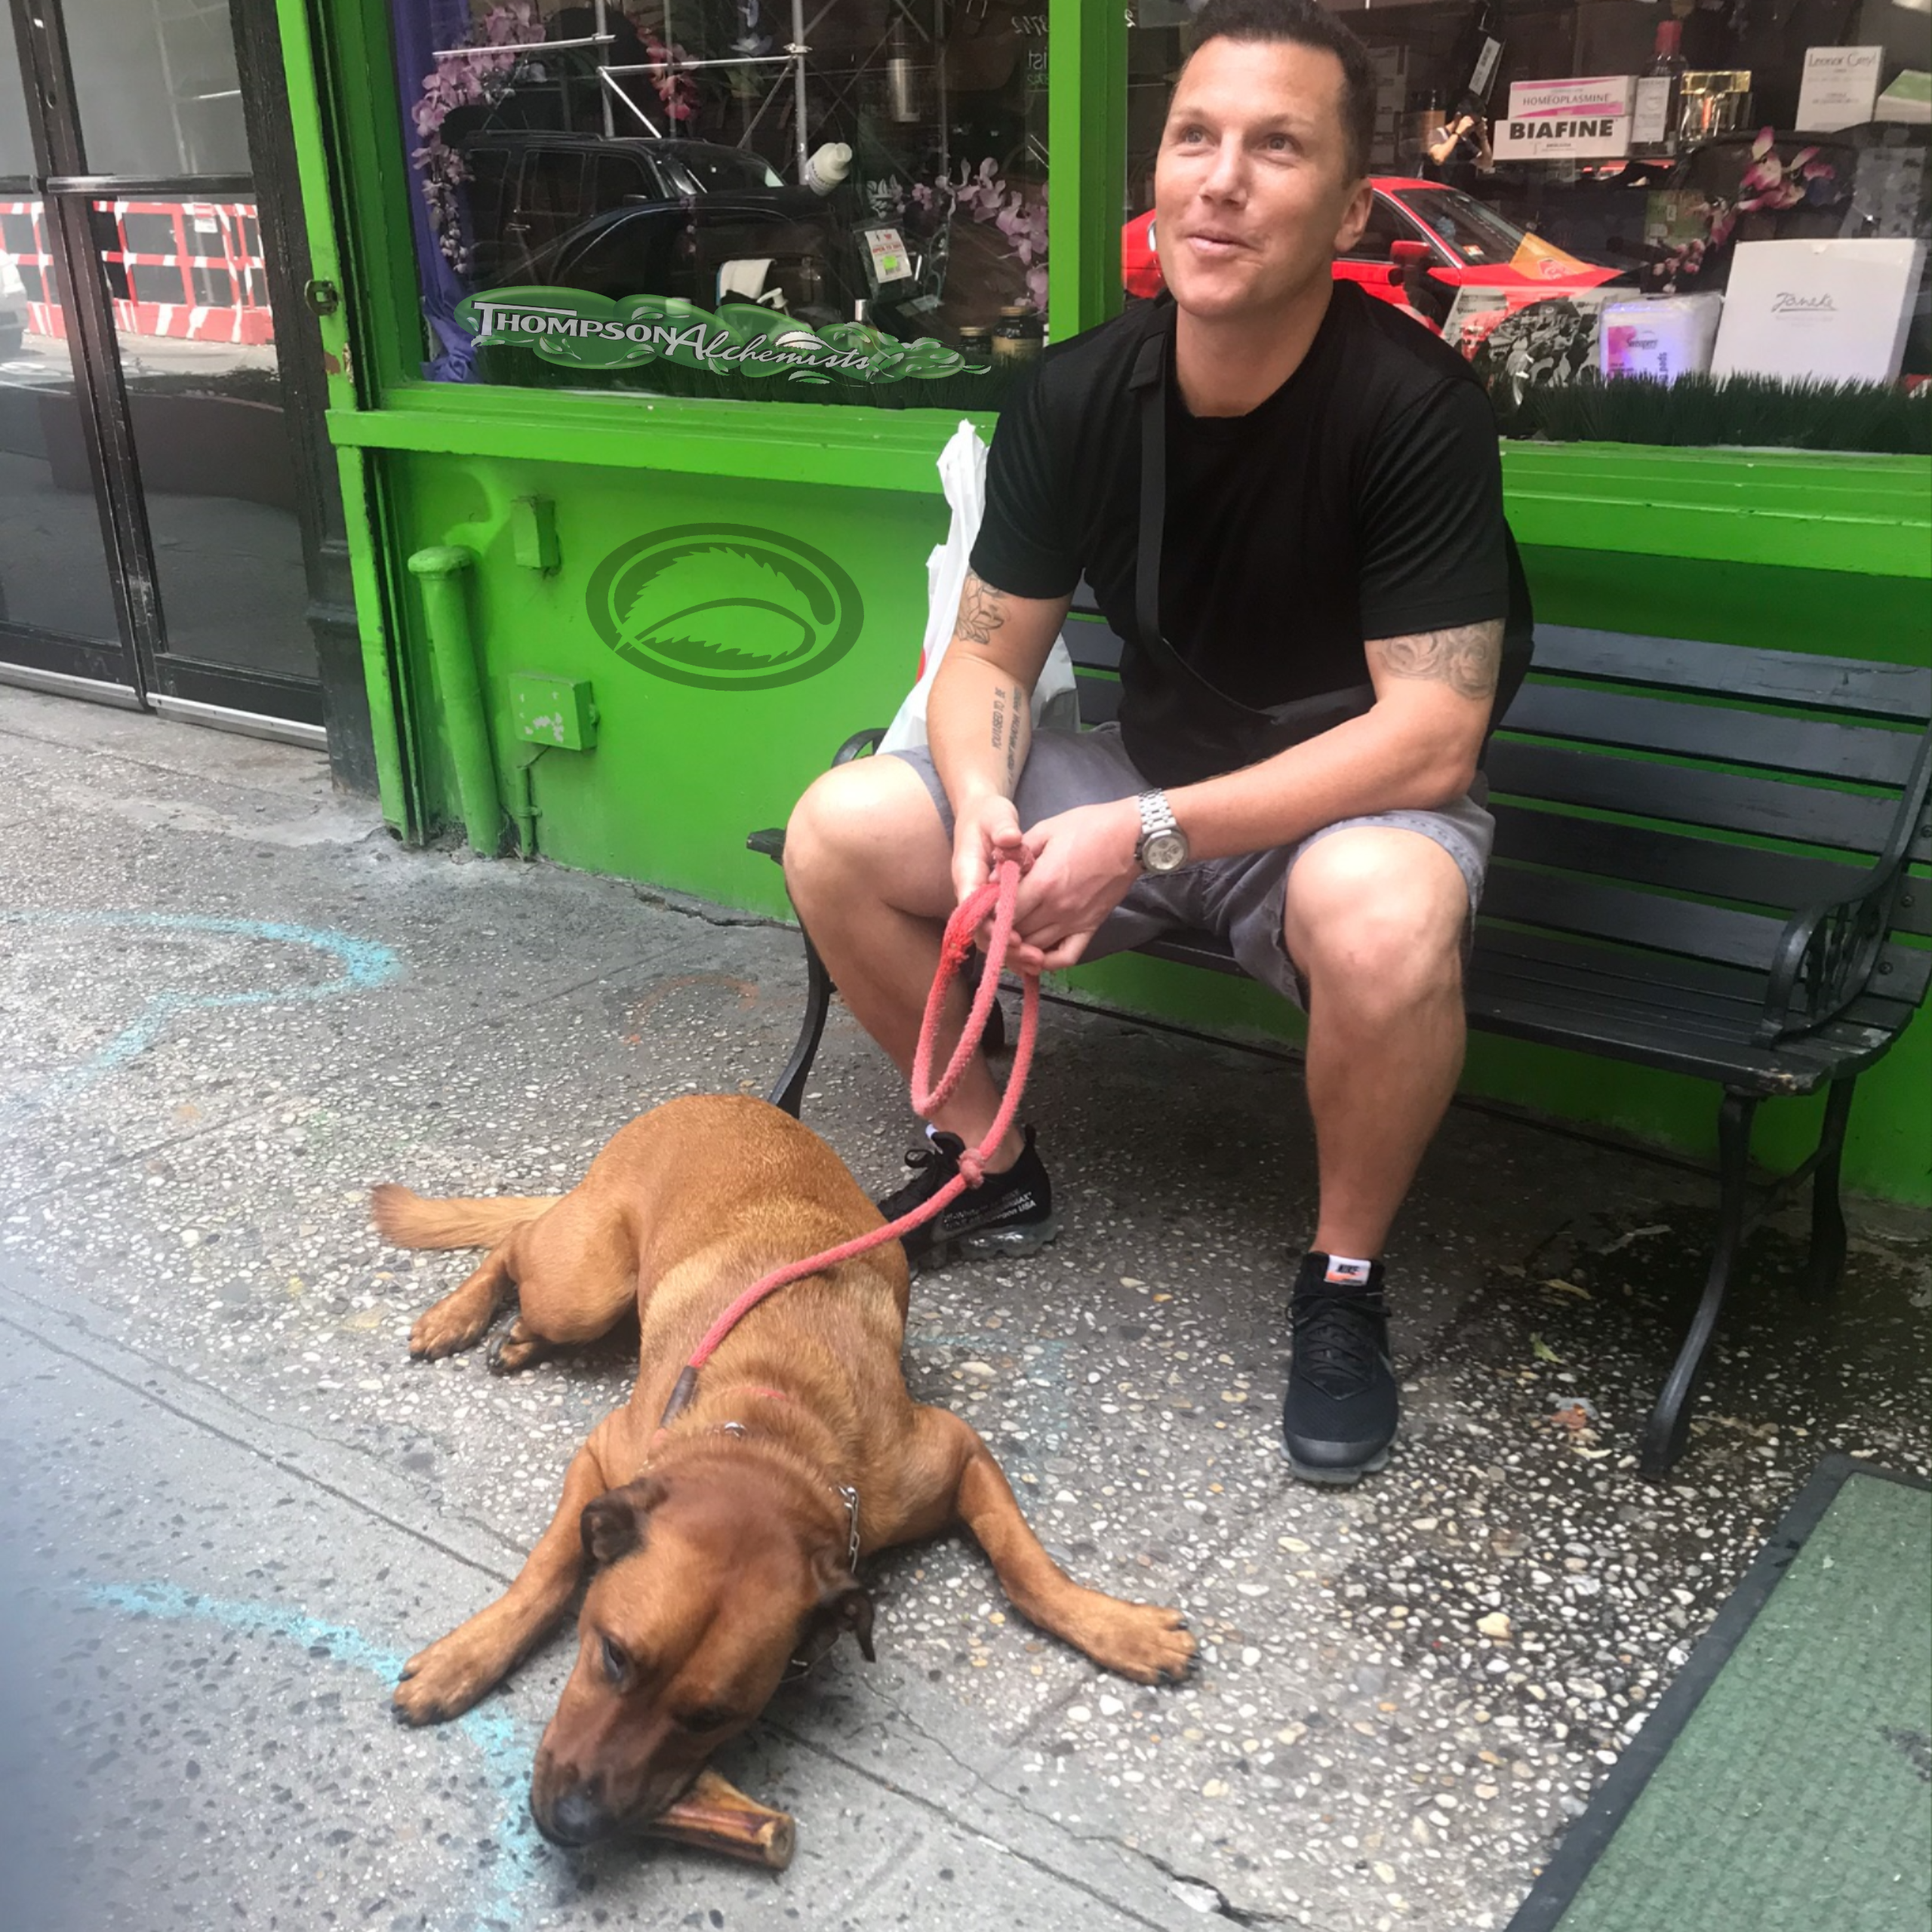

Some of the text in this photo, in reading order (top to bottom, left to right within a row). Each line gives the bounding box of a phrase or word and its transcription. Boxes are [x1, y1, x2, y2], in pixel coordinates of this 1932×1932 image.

[1509, 119, 1614, 140] BIAFINE
[471, 302, 872, 371] THOMPSON Alchemists
